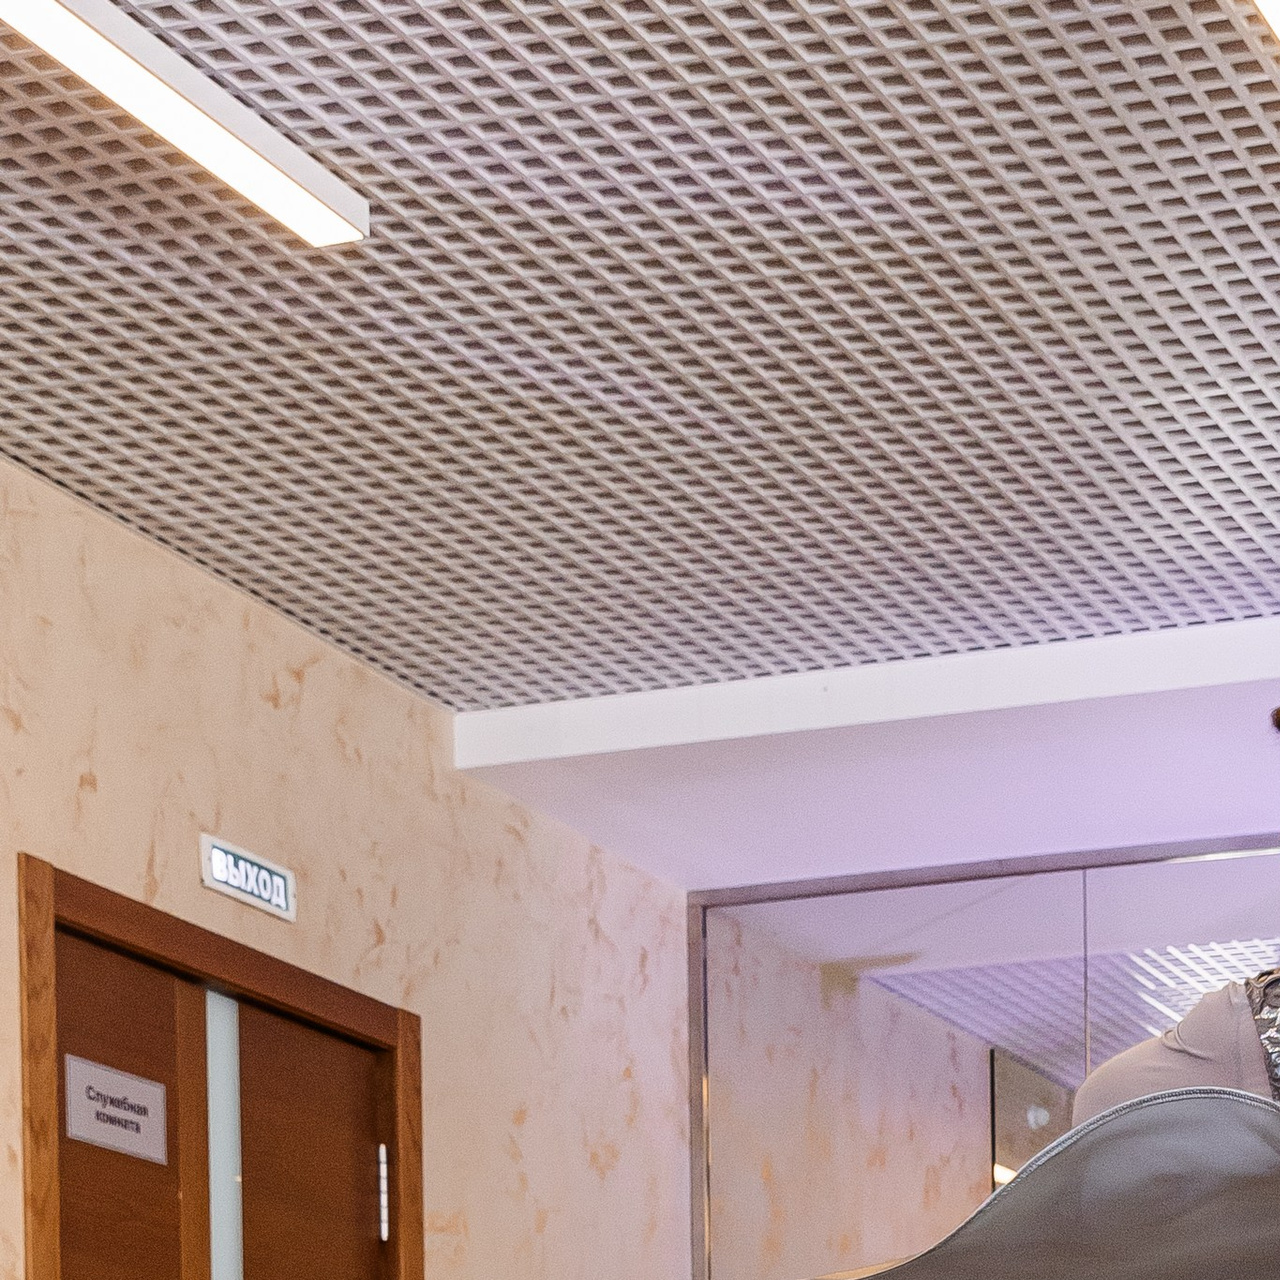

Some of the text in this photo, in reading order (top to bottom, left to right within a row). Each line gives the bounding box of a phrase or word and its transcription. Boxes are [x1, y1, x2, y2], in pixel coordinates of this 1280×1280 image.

[211, 847, 287, 911] ВЫХОД
[85, 1084, 149, 1117] Служебная
[94, 1109, 142, 1134] комната
